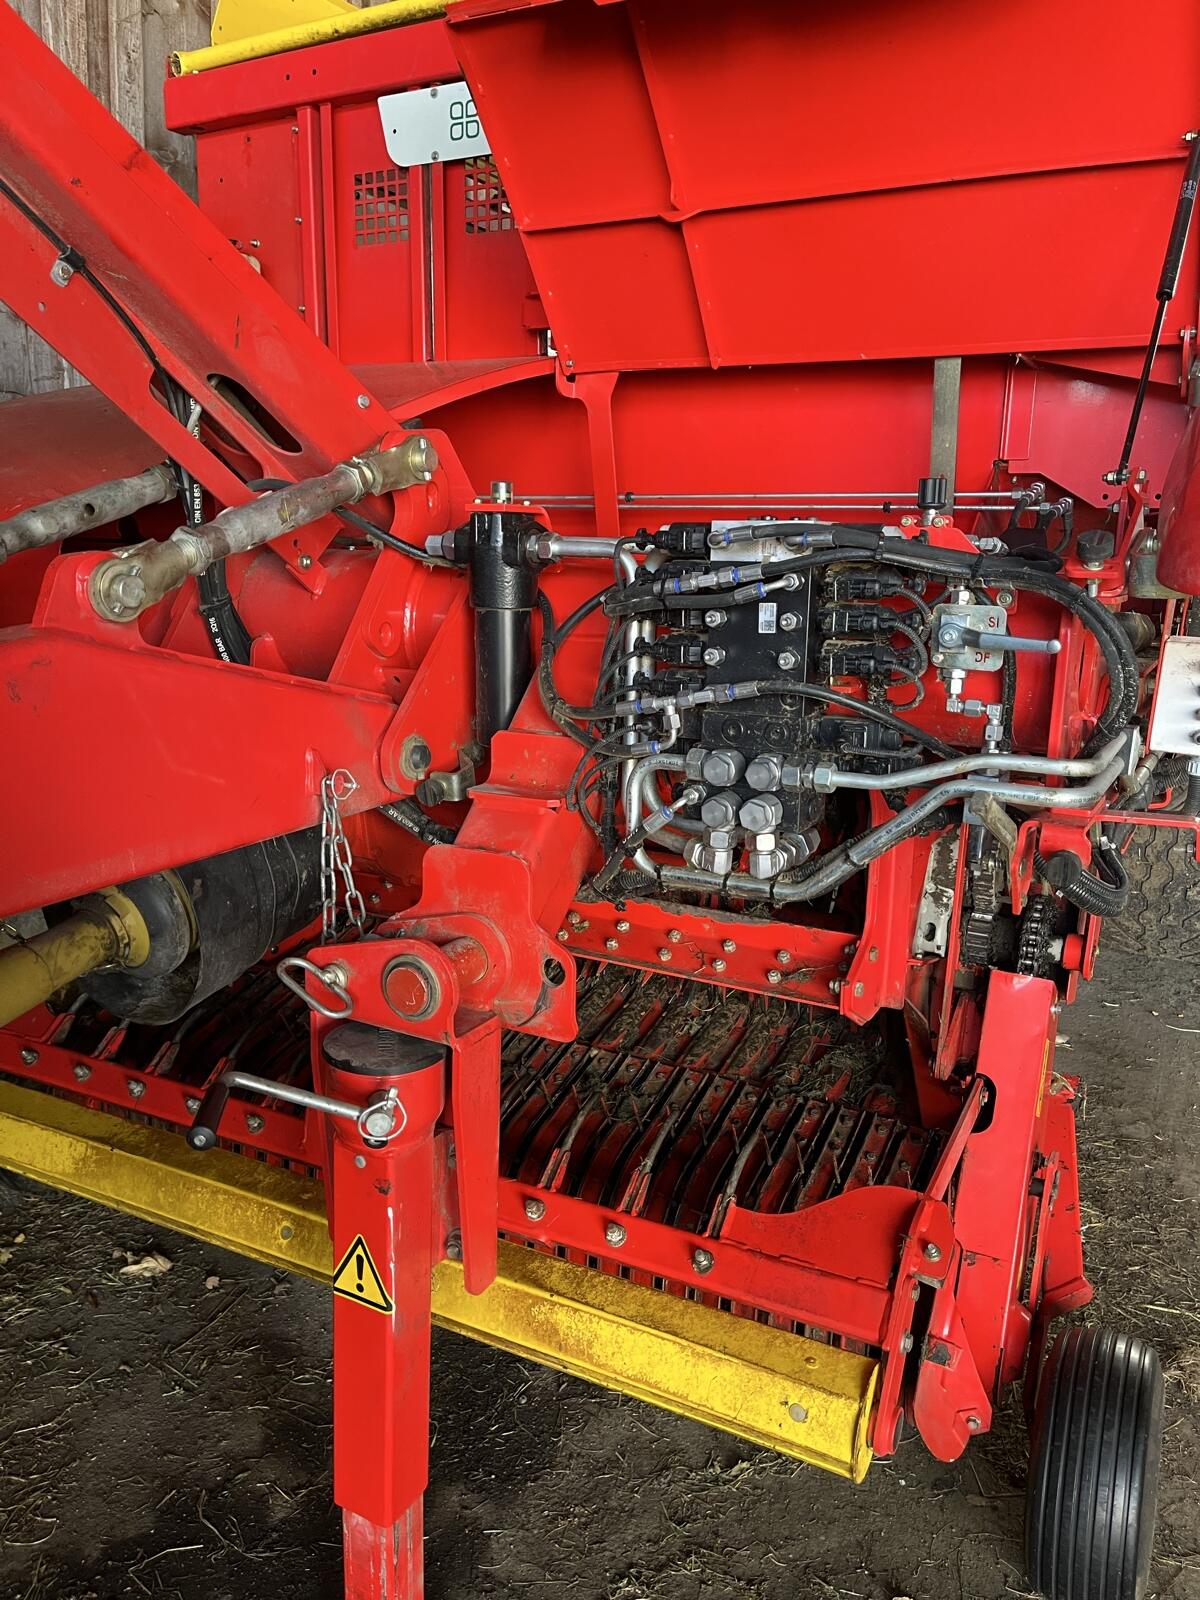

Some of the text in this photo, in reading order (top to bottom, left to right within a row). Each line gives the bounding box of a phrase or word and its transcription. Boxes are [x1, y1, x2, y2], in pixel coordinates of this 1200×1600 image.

[193, 498, 201, 509] EN
[194, 510, 202, 523] DIN
[215, 637, 225, 652] BAR
[388, 808, 402, 821] BAR
